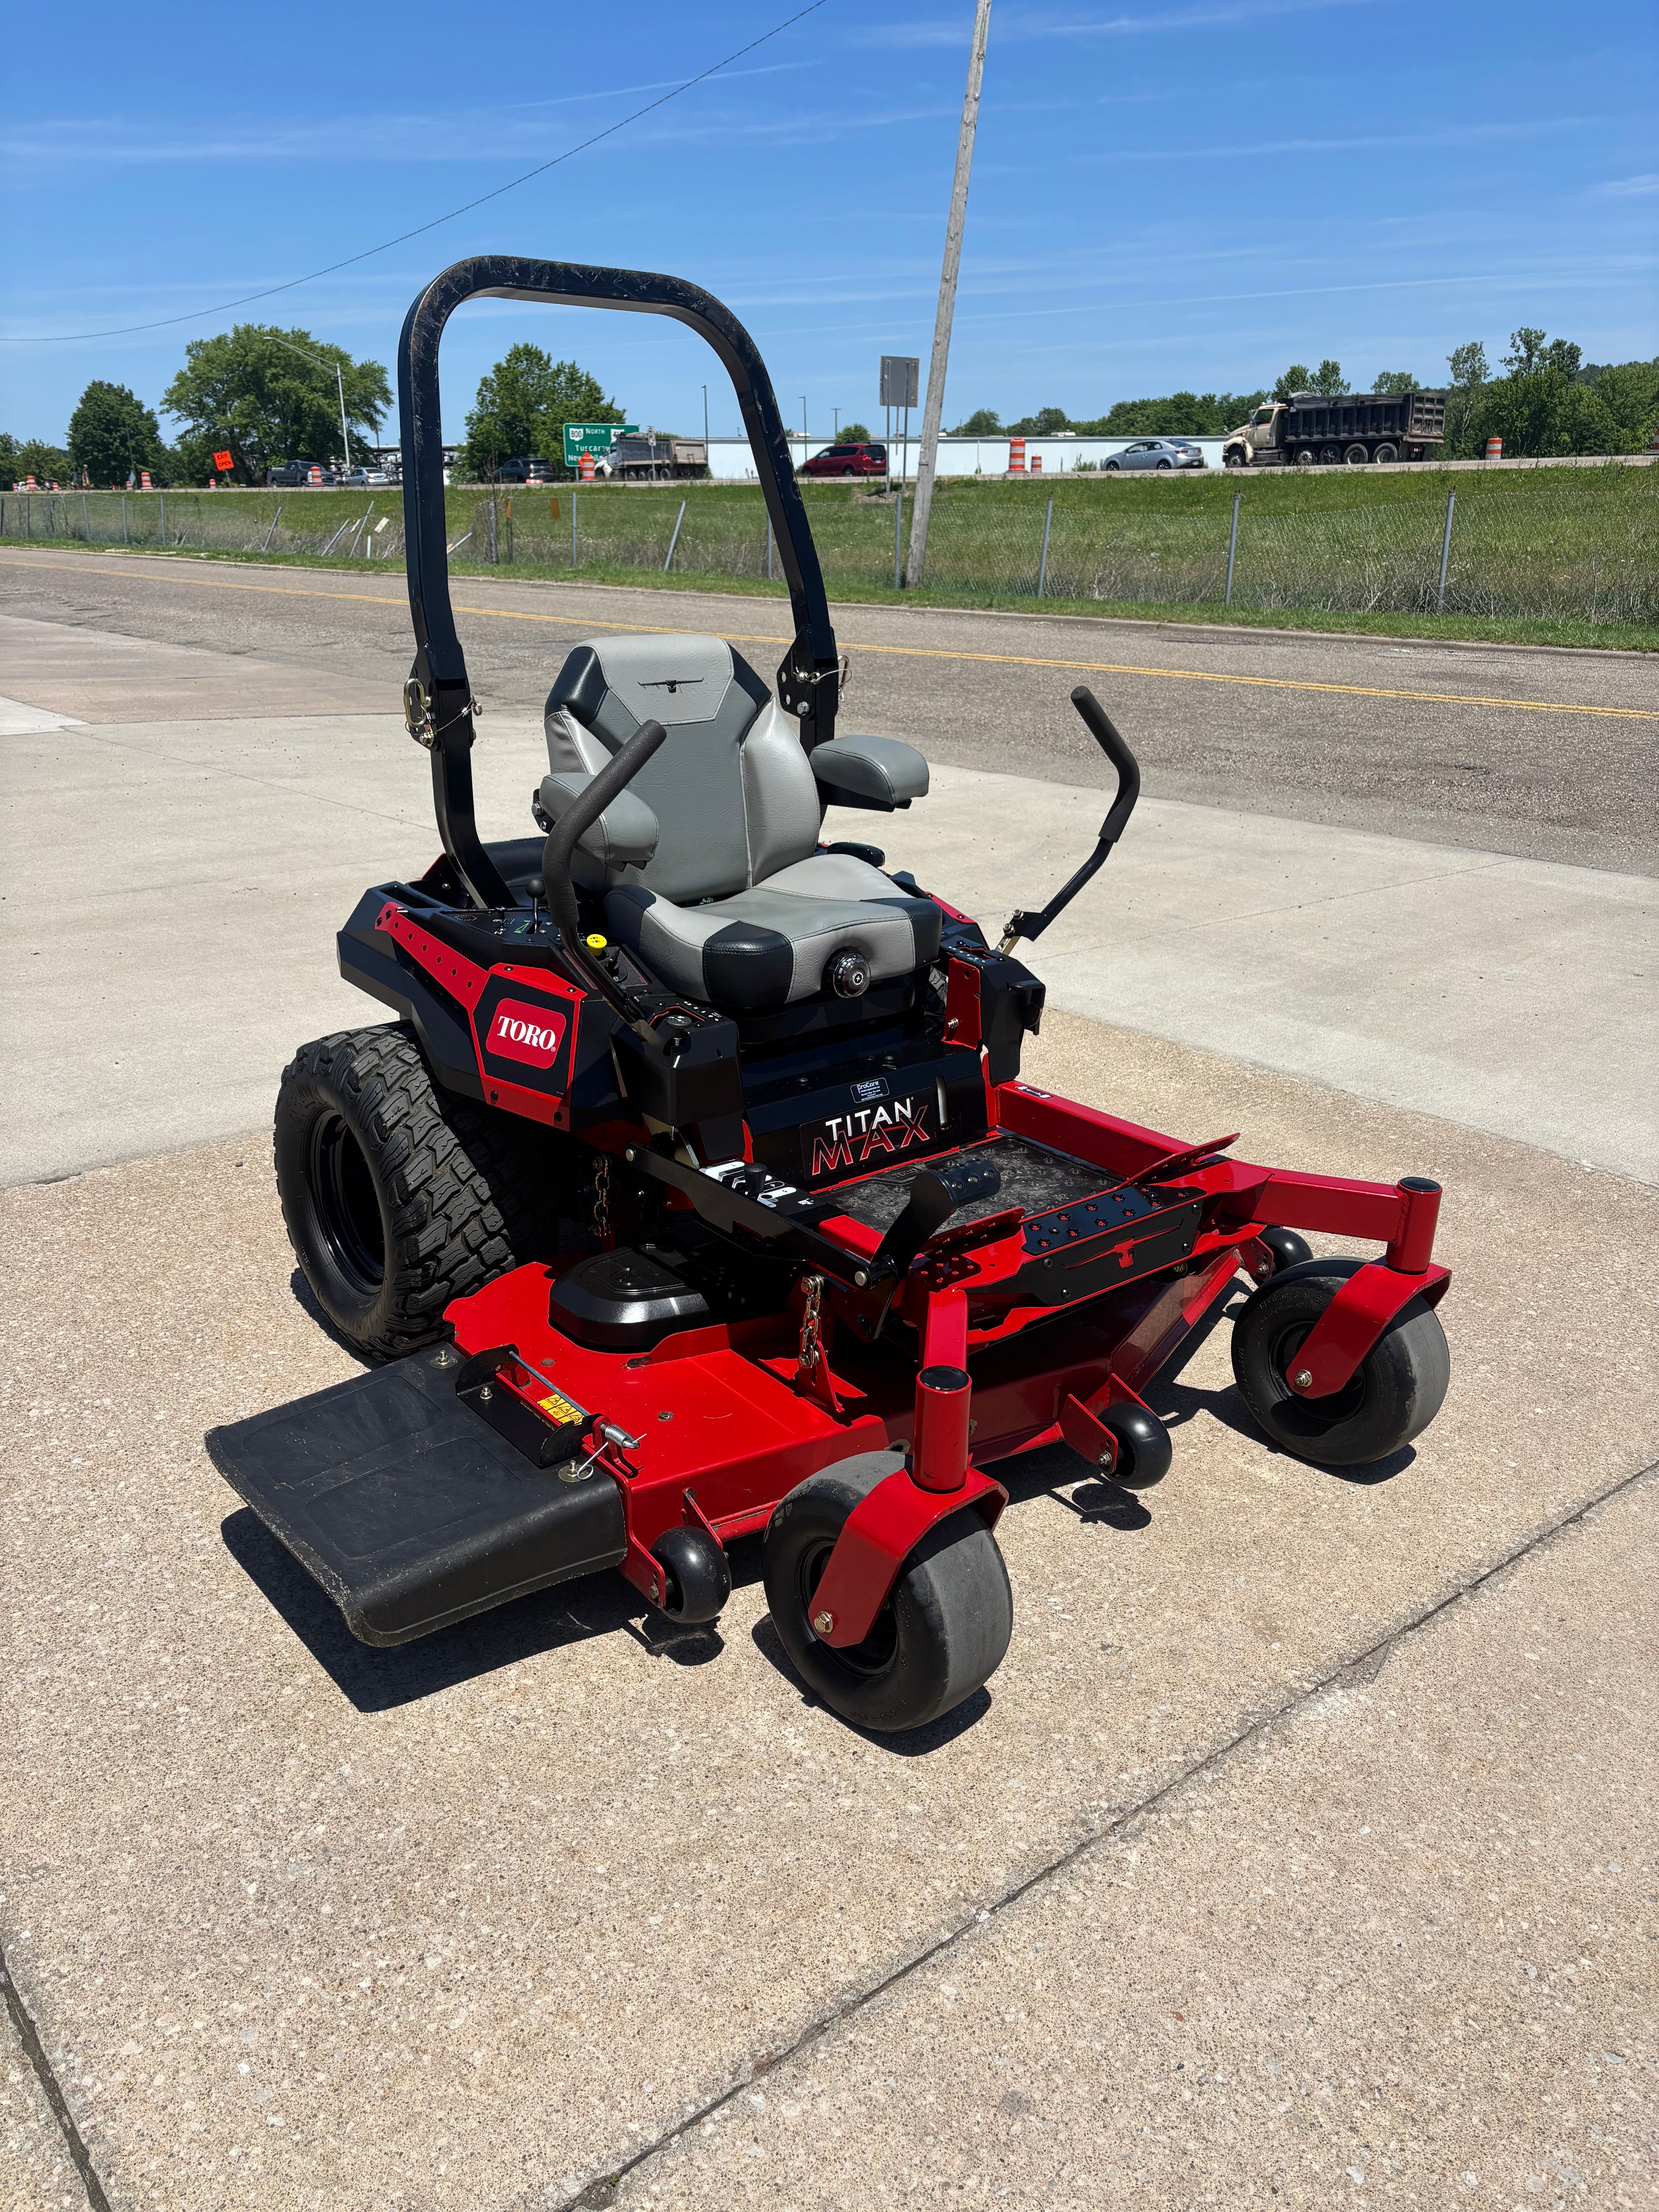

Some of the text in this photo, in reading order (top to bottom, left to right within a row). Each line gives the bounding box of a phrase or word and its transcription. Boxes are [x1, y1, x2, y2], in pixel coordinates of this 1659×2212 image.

[497, 1015, 556, 1050] TORO
[857, 1081, 879, 1093] ProCore
[825, 1098, 911, 1141] TITAN
[812, 1105, 930, 1176] MAX
